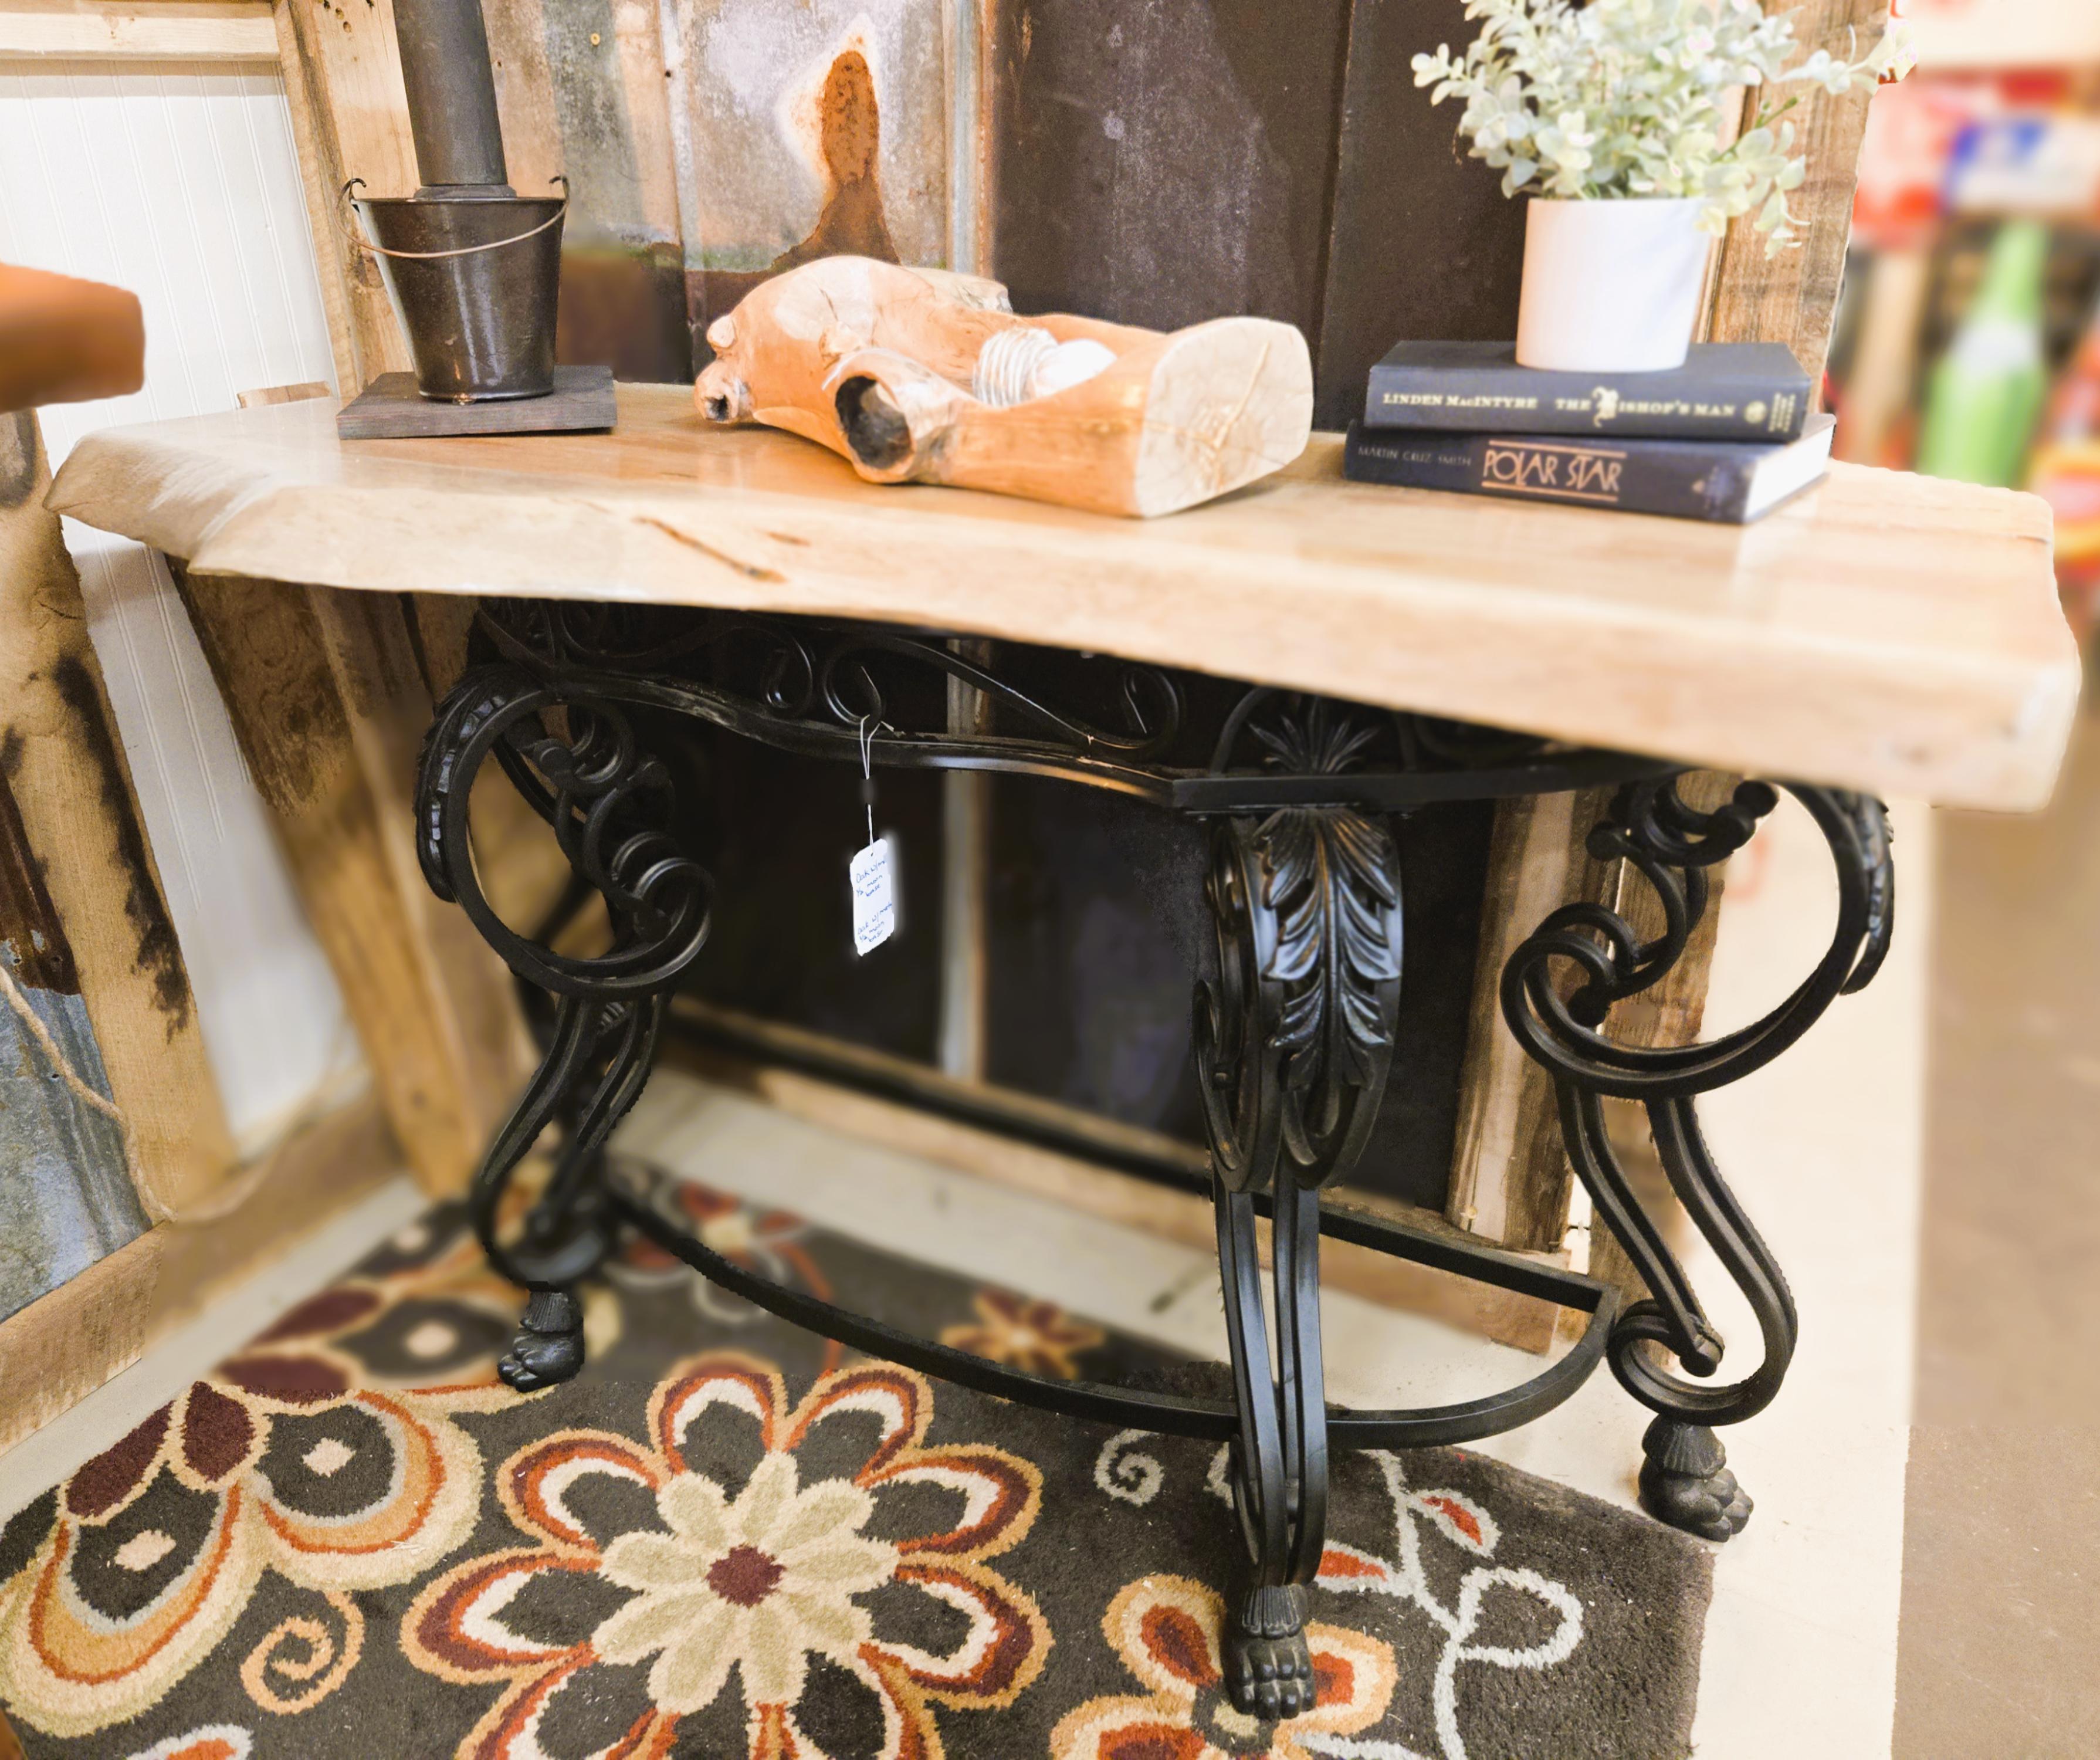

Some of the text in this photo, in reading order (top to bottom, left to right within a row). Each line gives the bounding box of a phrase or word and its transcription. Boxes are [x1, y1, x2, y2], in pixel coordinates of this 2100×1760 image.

[1383, 393, 1442, 405] LINDEN
[1555, 398, 1591, 411] THE
[1693, 404, 1735, 417] MAN
[1358, 446, 1472, 466] MARTIN CRUZ SMITH
[1483, 449, 1622, 492] POLAR STAR
